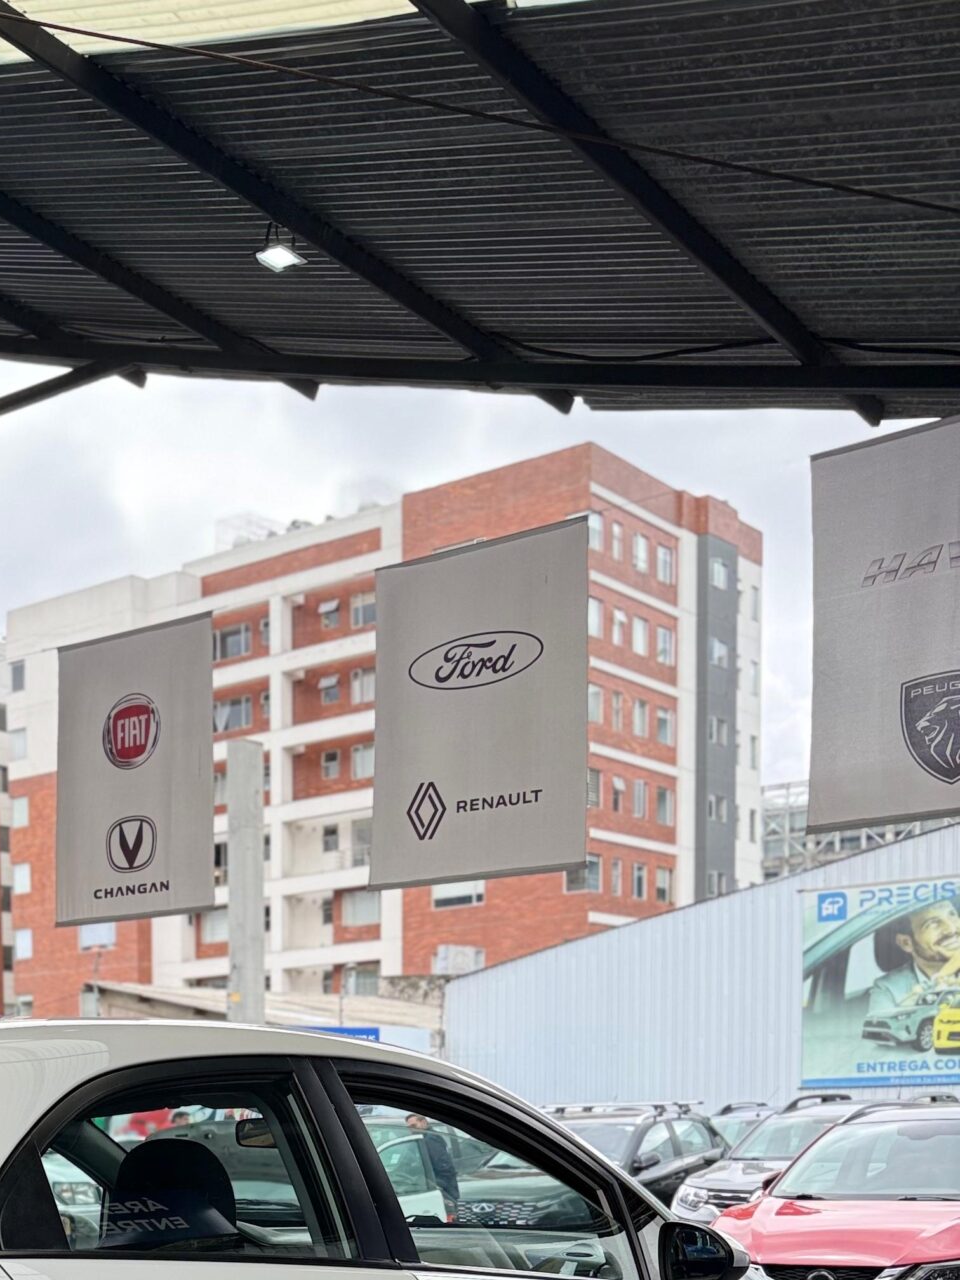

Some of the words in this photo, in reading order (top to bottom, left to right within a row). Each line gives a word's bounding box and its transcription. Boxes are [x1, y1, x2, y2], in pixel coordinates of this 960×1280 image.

[435, 640, 517, 683] Ford
[117, 714, 149, 750] FIAT
[456, 789, 543, 813] RENAULT
[94, 880, 170, 899] CHANGAN
[856, 1061, 930, 1073] ENTREGA
[934, 1059, 960, 1070] CO
